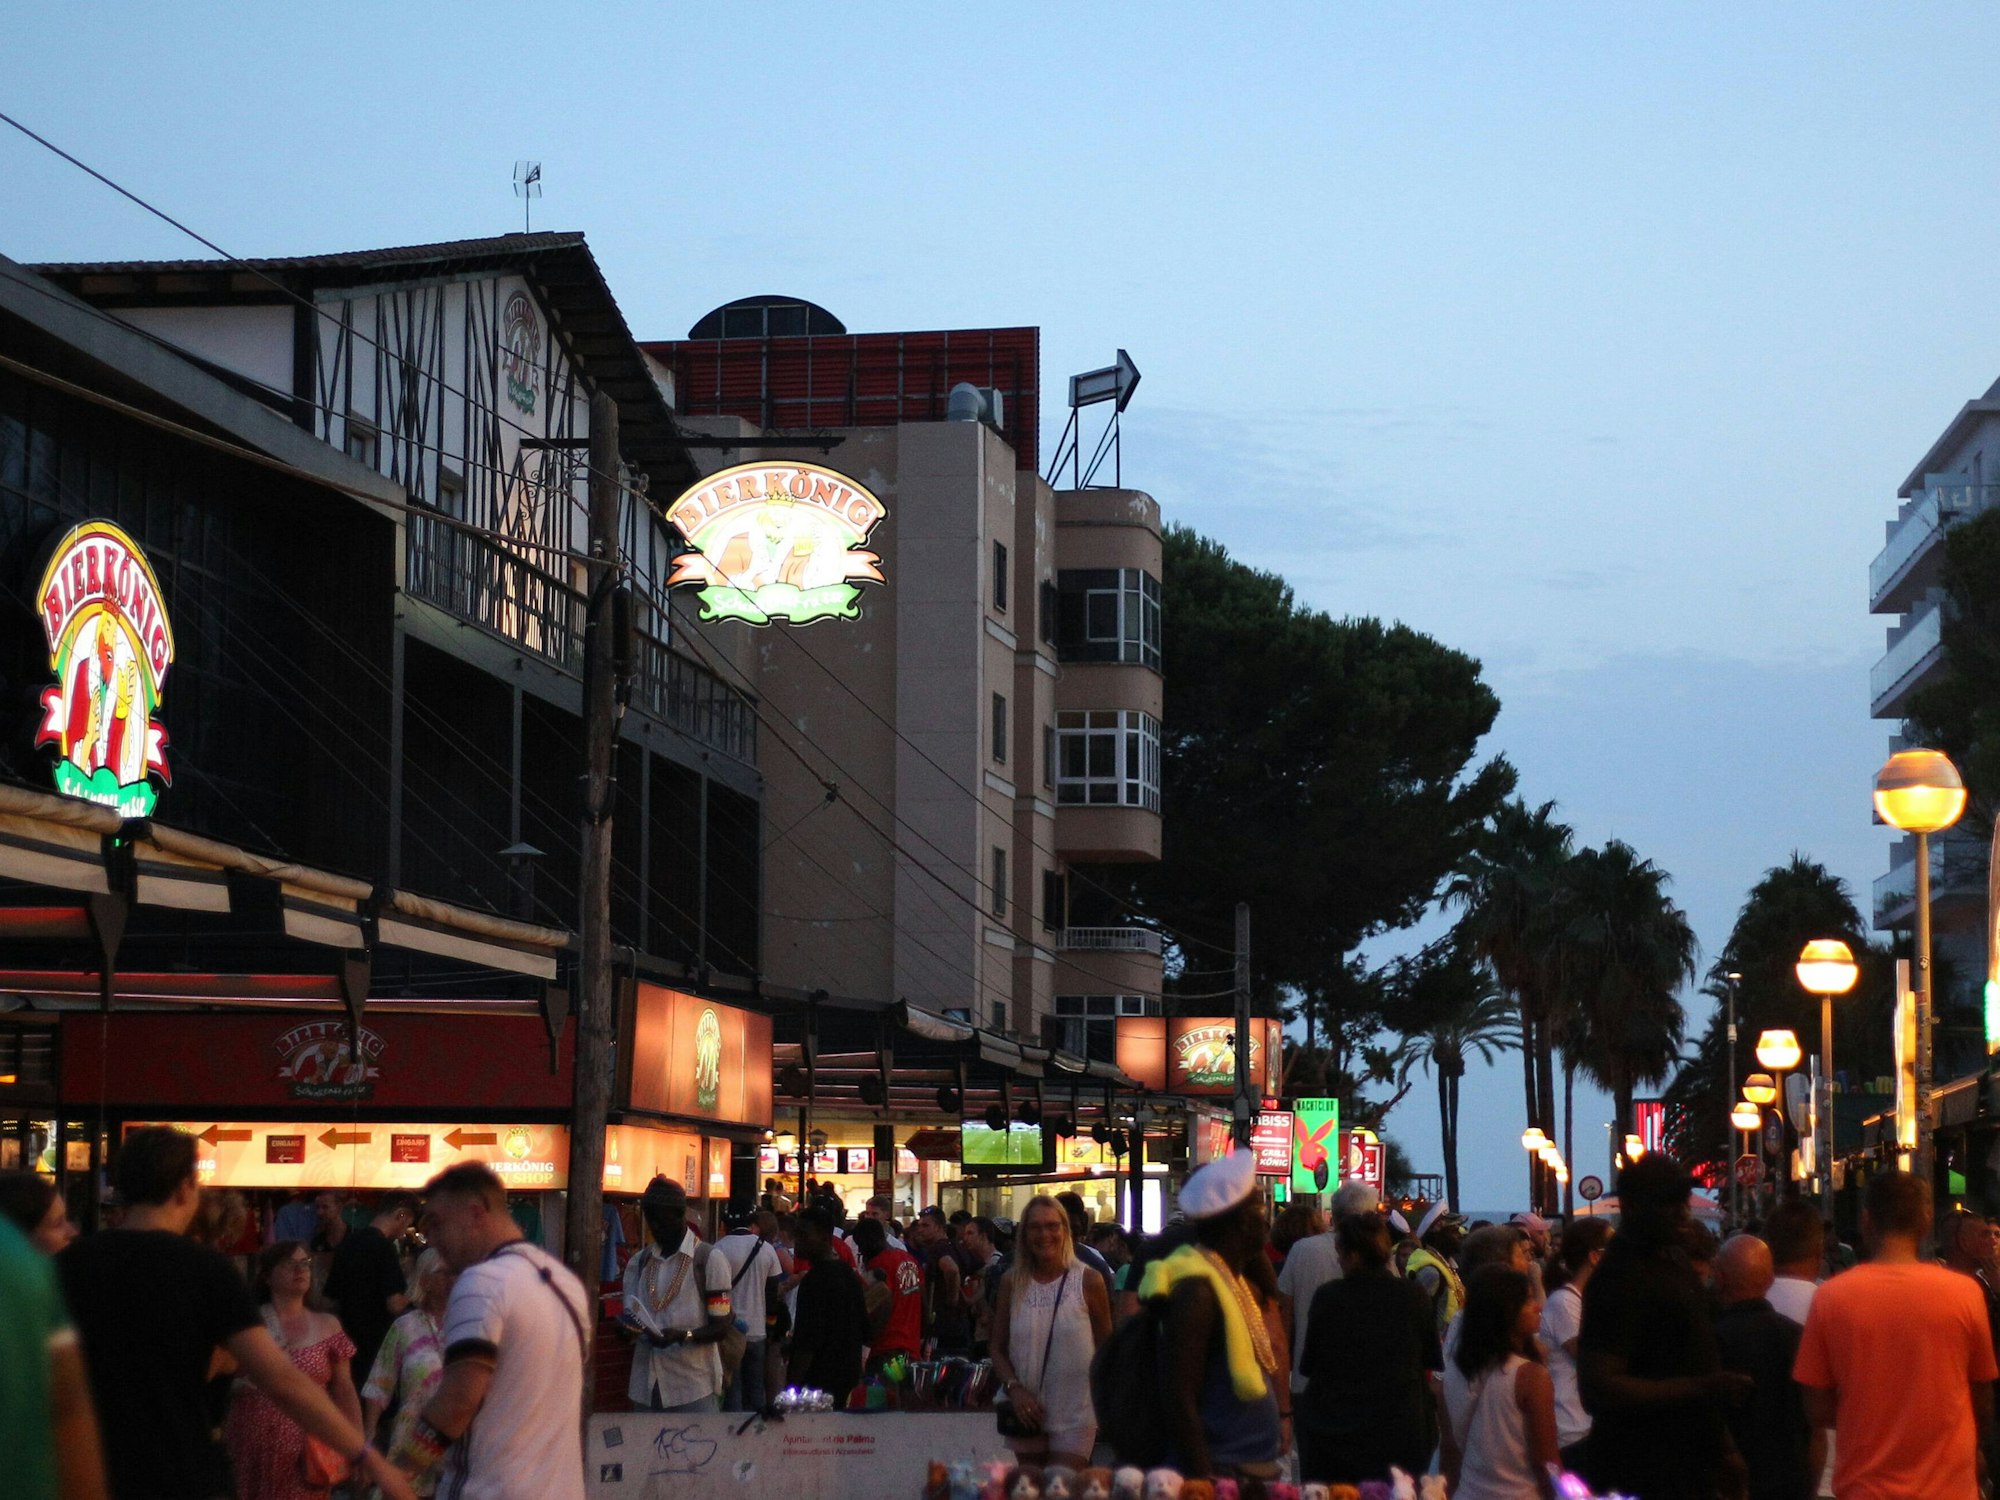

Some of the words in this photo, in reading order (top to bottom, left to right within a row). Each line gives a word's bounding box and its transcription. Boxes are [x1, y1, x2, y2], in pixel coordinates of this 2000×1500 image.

[675, 468, 875, 533] BIERKÖNIG
[46, 543, 169, 676] BIERKÖNIG
[1296, 1100, 1334, 1111] NACHTCLUB
[1261, 1149, 1287, 1158] GRILL
[490, 1161, 555, 1172] IERKÖNIG
[1259, 1158, 1289, 1167] KÖNIG
[511, 1172, 554, 1184] SHOP
[846, 1434, 876, 1444] Palma
